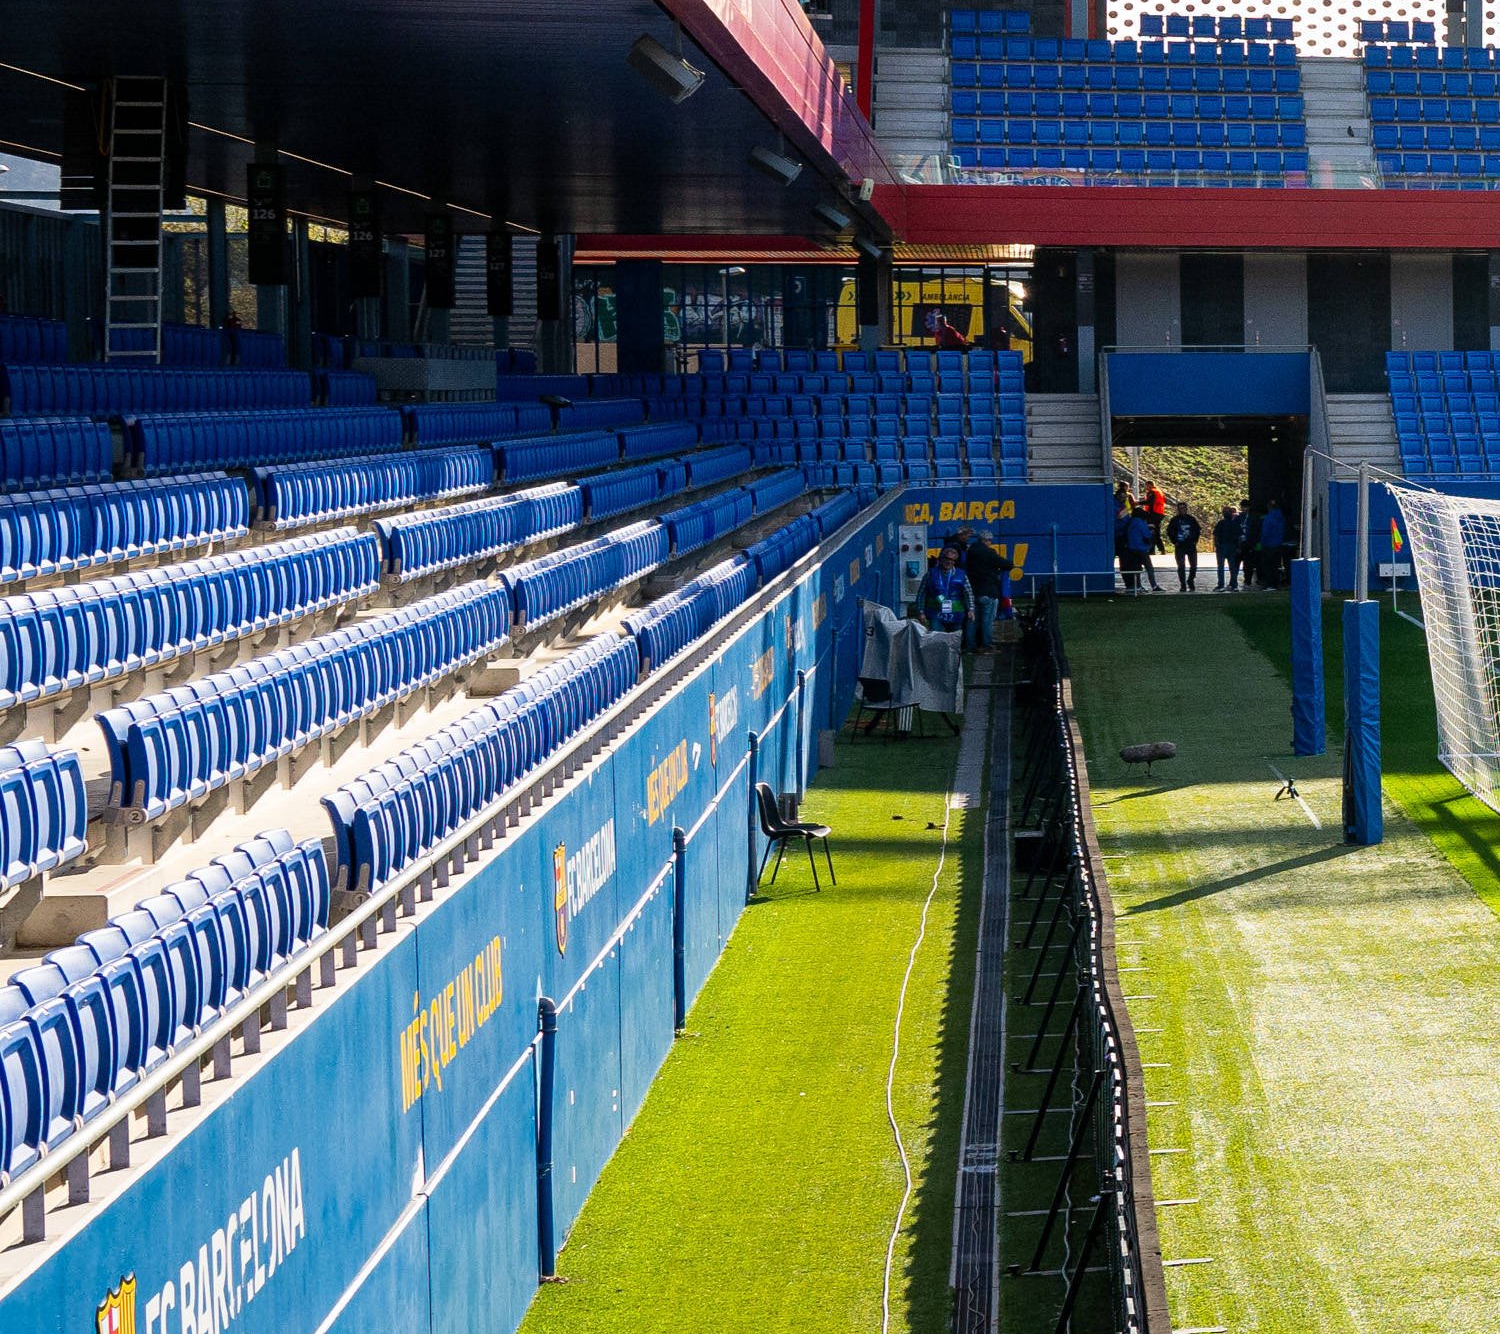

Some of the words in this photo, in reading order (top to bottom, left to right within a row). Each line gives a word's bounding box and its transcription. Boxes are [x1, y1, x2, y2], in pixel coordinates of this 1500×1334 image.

[252, 208, 276, 220] 126
[353, 230, 374, 241] 126
[938, 500, 1015, 523] BARÇA
[567, 855, 578, 922] FC
[575, 817, 616, 911] BARCELONA
[401, 990, 430, 1114] MÉS
[430, 981, 456, 1092] QUE
[456, 963, 475, 1048] UN
[475, 935, 503, 1027] CLUB
